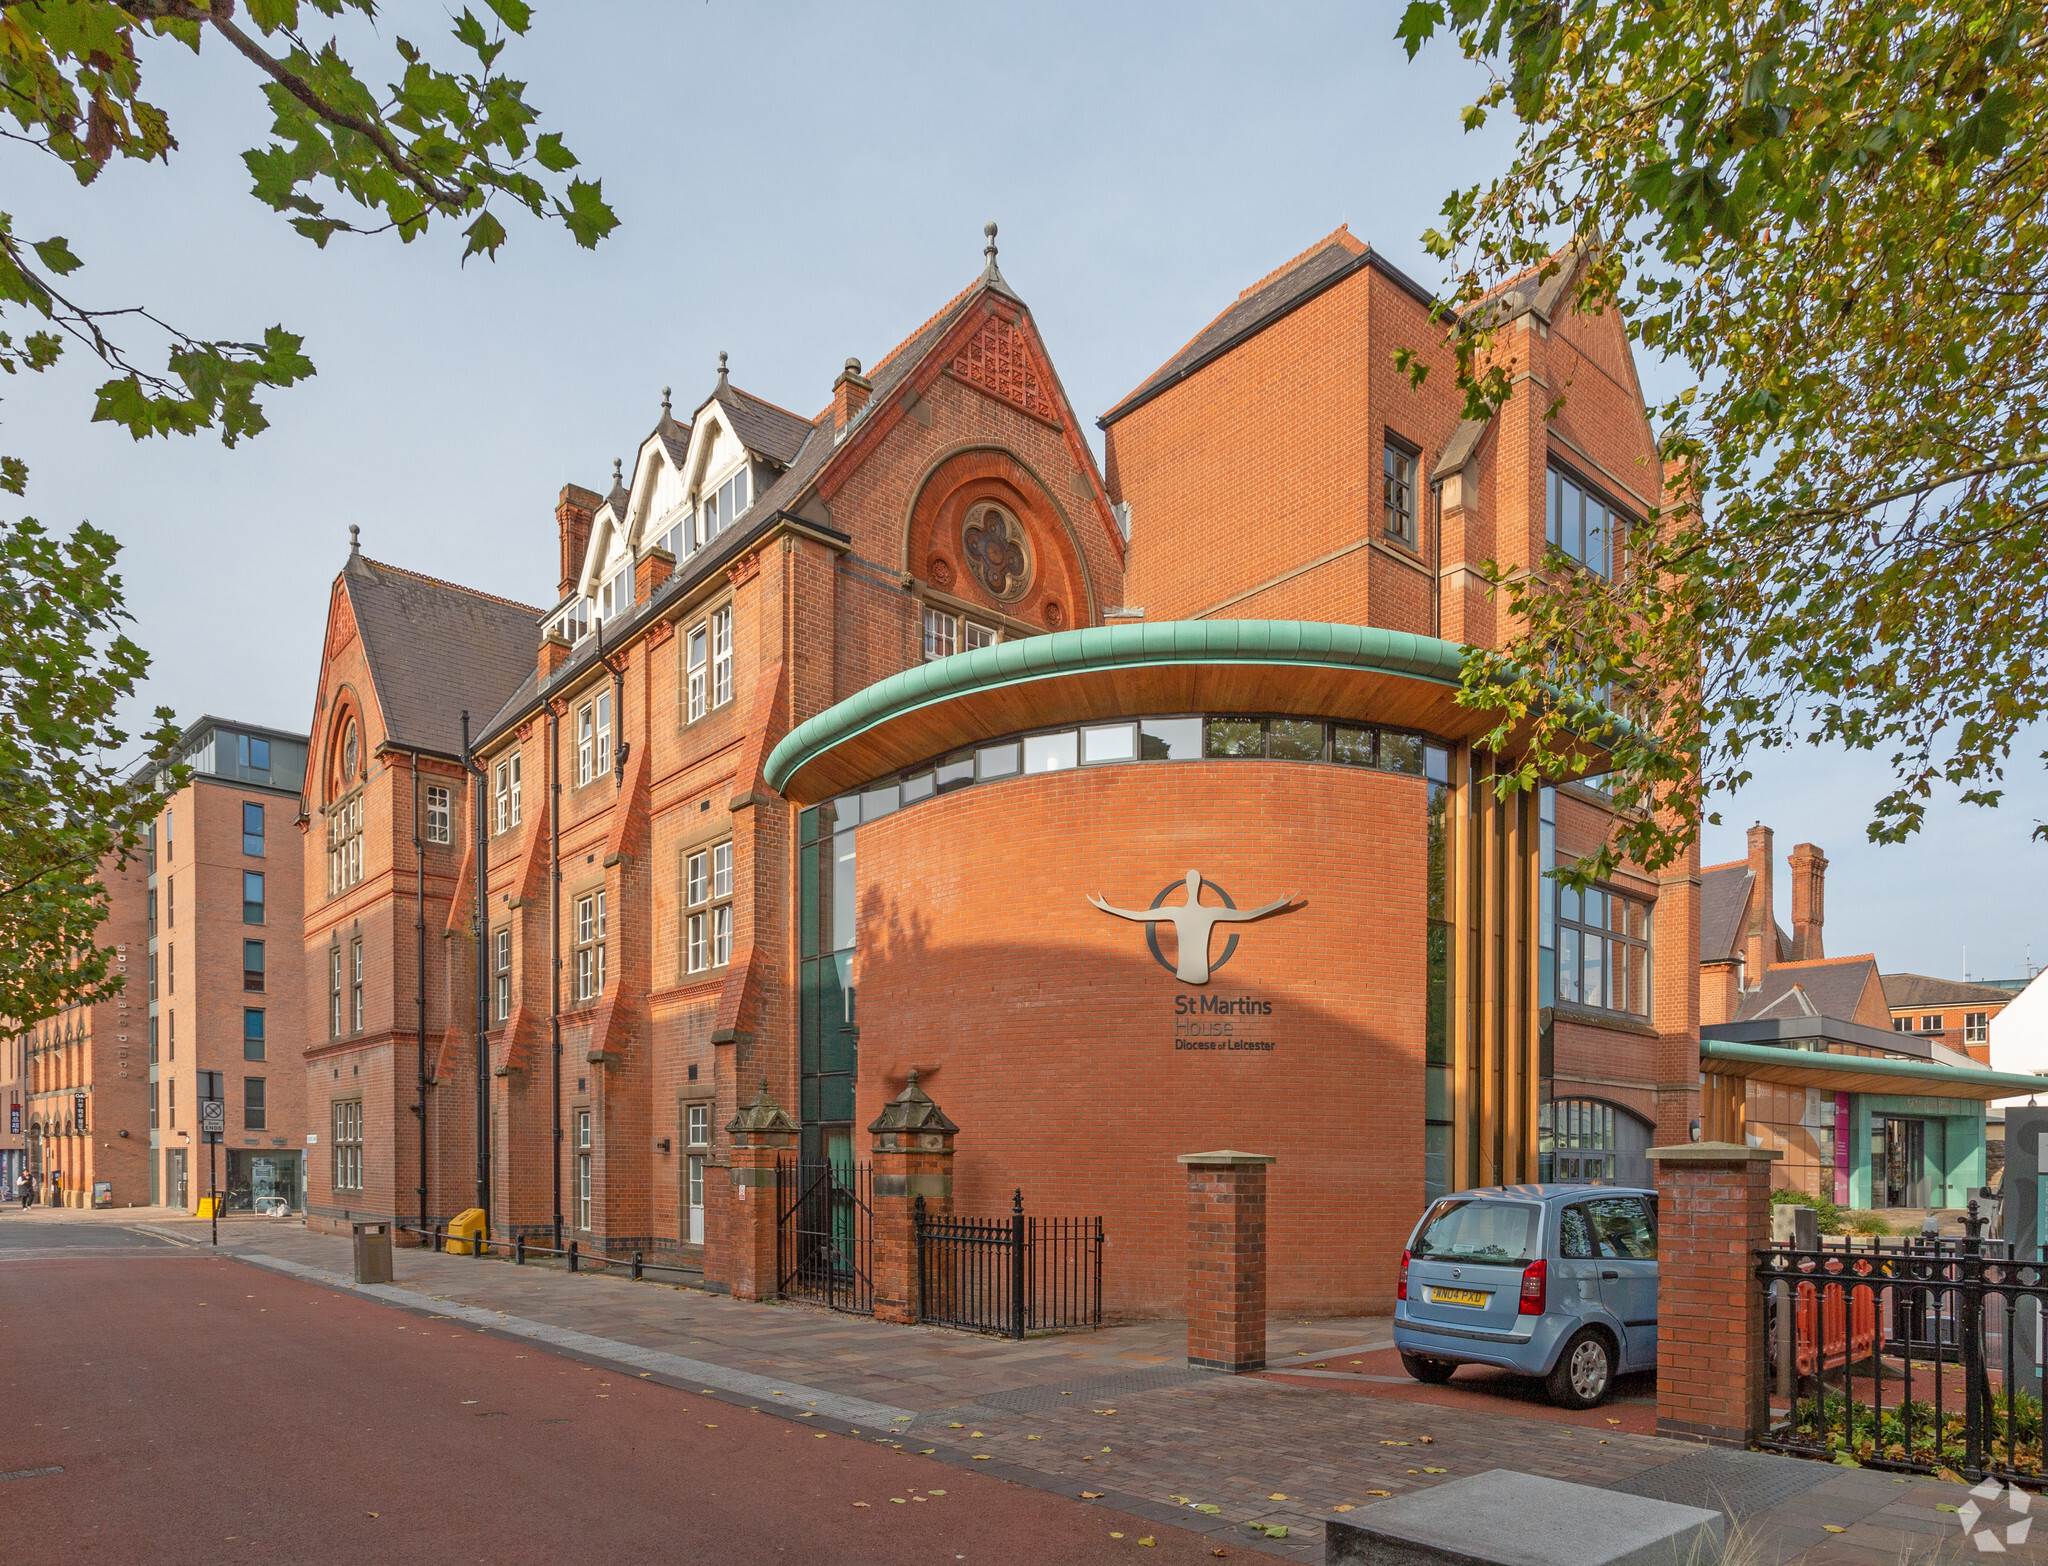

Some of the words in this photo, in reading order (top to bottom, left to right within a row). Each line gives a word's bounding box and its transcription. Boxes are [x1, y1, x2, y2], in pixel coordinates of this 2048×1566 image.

[1175, 994, 1196, 1014] St
[1200, 994, 1272, 1014] Martins
[1176, 1017, 1233, 1036] House
[1175, 1039, 1216, 1050] Diocese
[1218, 1040, 1225, 1050] of
[1228, 1039, 1275, 1050] Leicester
[116, 1034, 129, 1079] place
